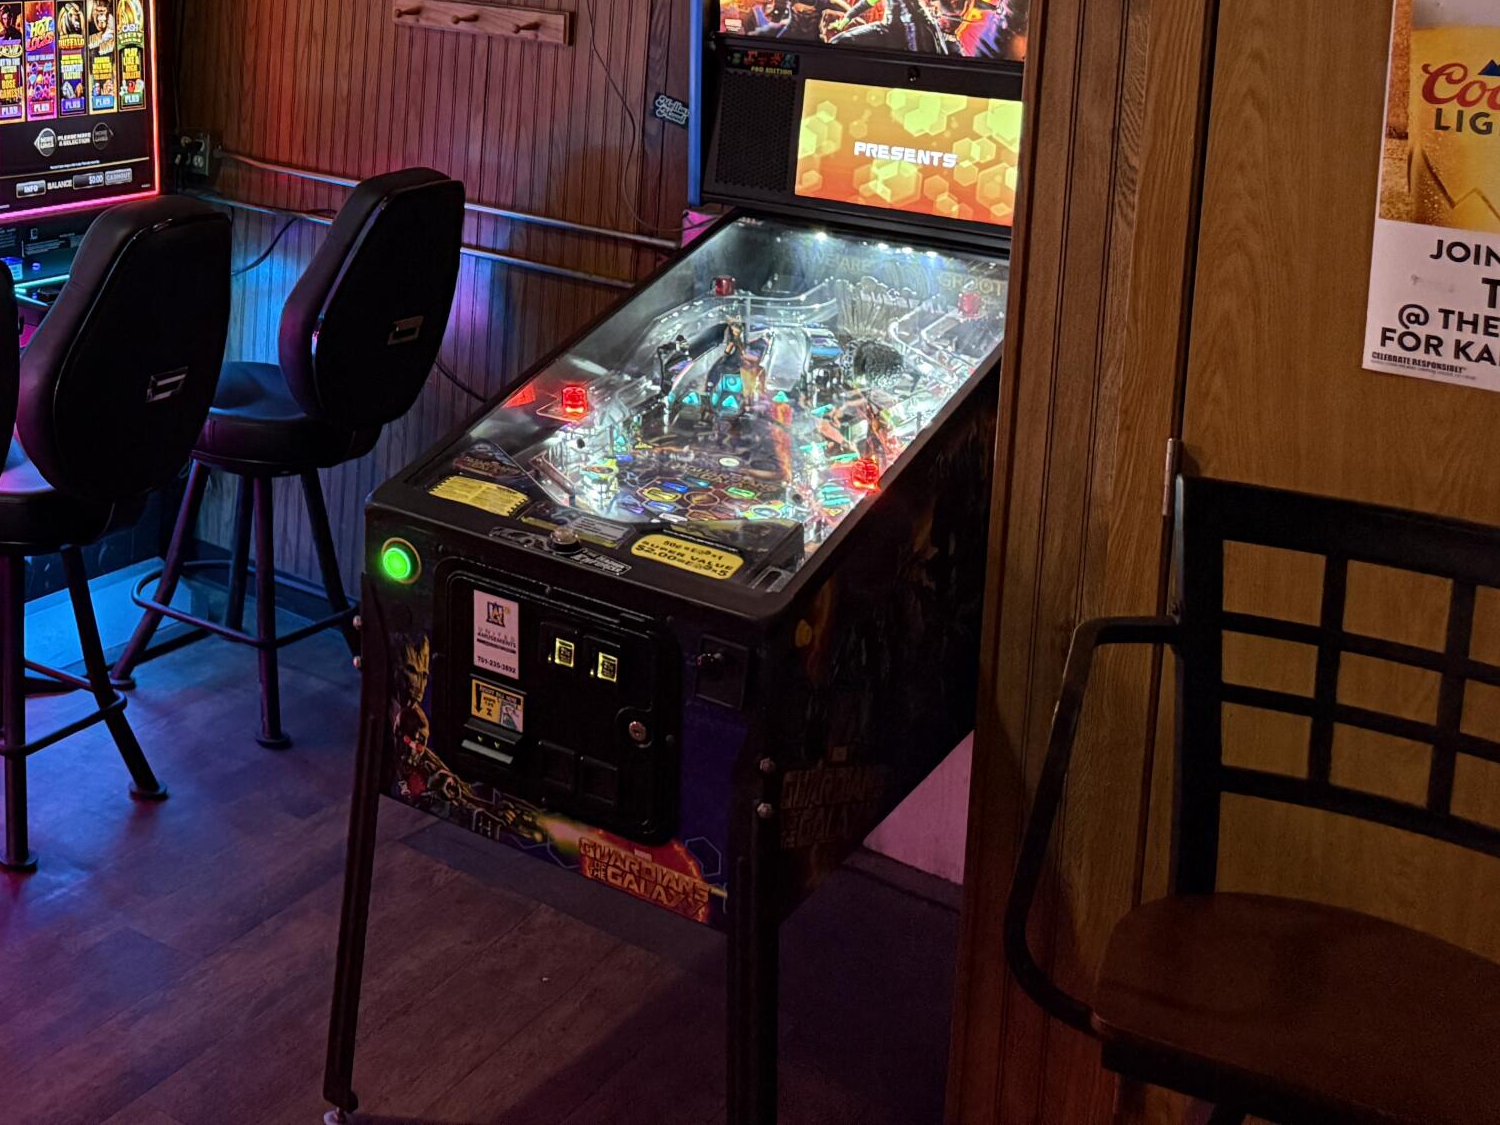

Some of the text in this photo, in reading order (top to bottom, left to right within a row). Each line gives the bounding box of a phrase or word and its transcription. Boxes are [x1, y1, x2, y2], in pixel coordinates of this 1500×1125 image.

[853, 140, 958, 169] PRESENTS
[837, 257, 1007, 296] ARE GROOT
[1398, 303, 1500, 338] @ THE
[1380, 326, 1444, 358] FOR
[1371, 351, 1411, 366] CELEBRATE
[1411, 357, 1464, 374] RESPONSIBLY
[579, 836, 710, 903] GUARDIANS
